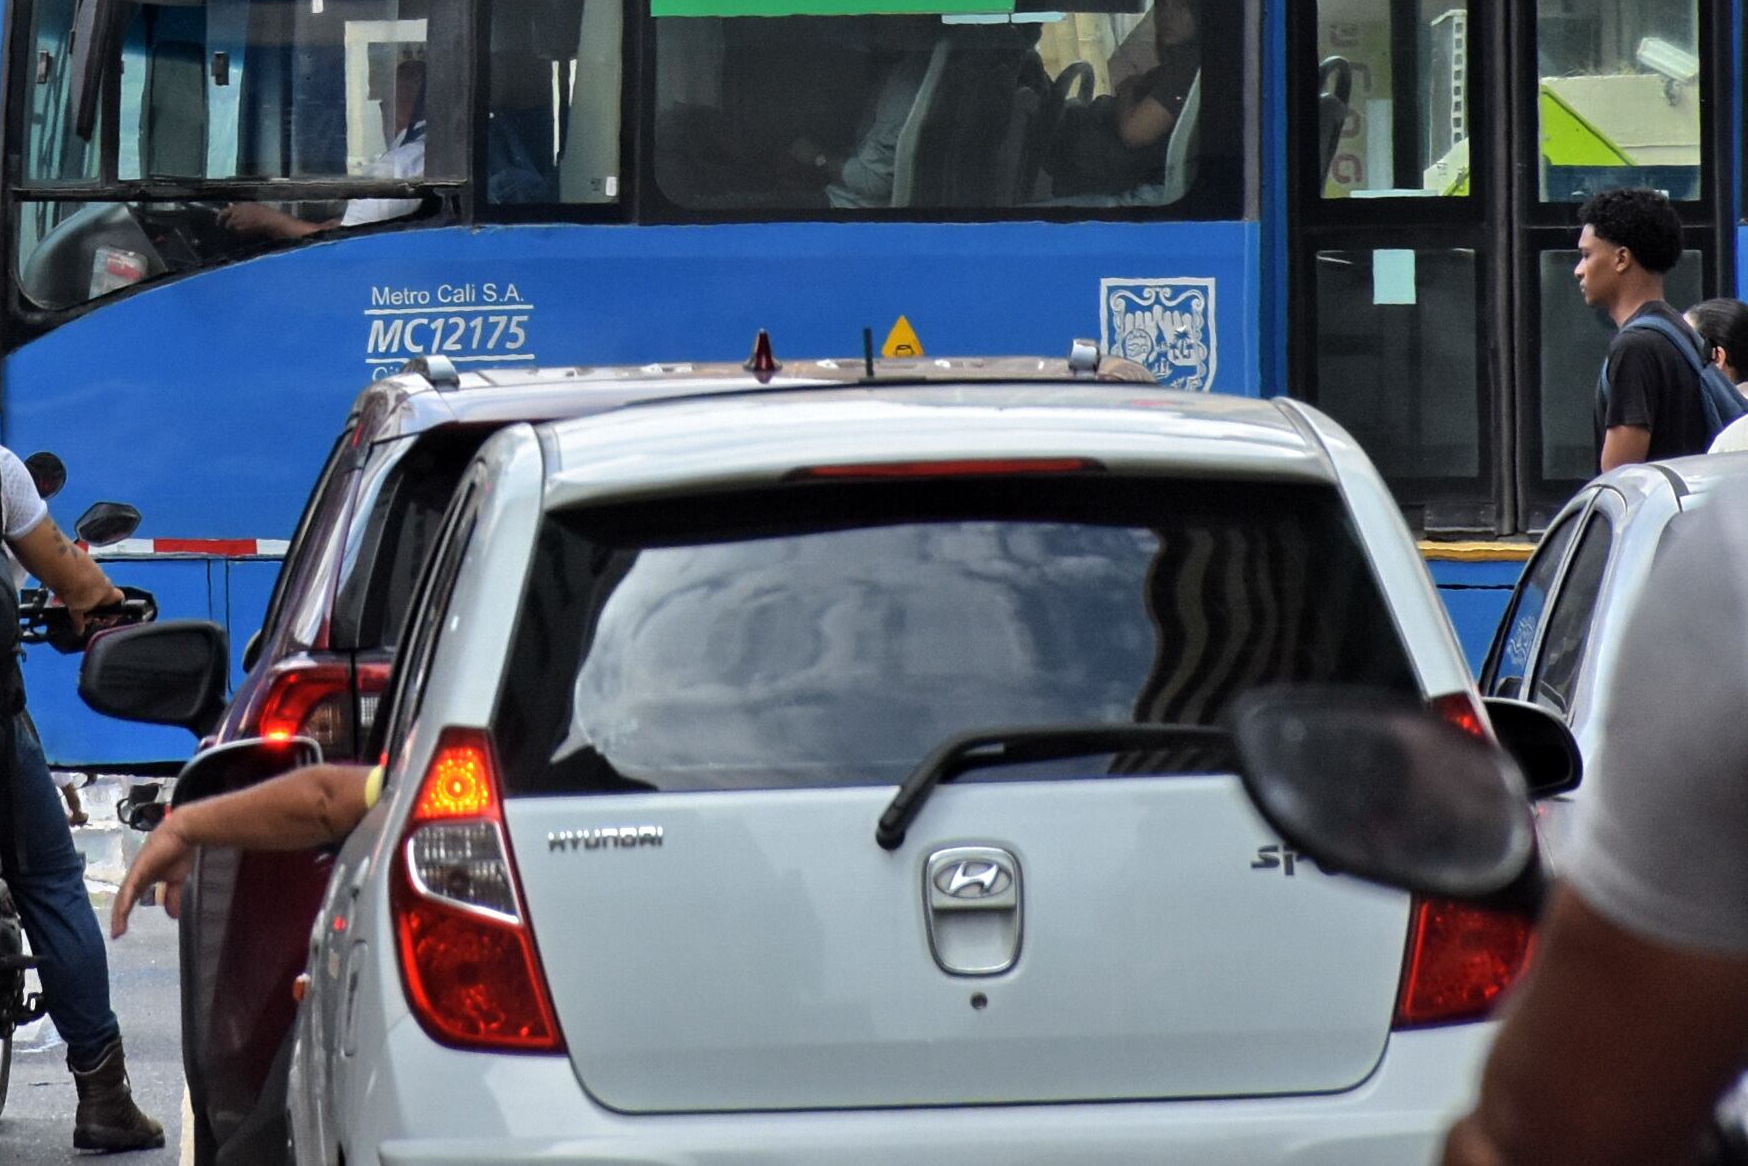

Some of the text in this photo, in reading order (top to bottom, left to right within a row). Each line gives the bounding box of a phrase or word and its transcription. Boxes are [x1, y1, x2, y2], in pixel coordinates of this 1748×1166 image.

[371, 283, 525, 306] Metro Cali S.A.
[367, 315, 530, 355] MC12175
[548, 826, 663, 852] HYUNDAI
